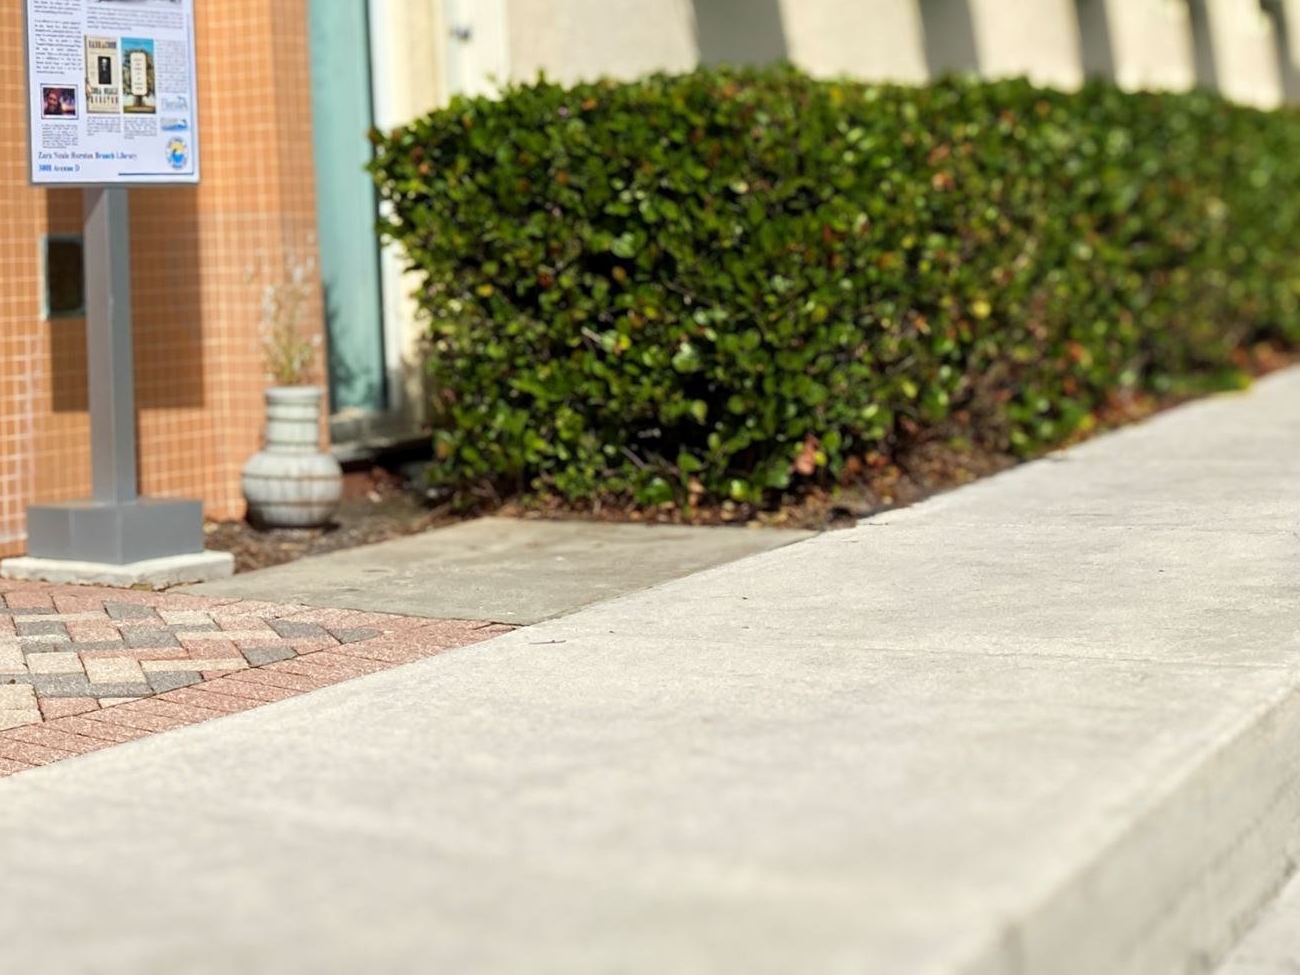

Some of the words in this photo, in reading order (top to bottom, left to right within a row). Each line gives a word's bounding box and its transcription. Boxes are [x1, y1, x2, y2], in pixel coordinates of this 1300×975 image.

[38, 151, 52, 160] Zora
[53, 151, 69, 160] Neale
[71, 151, 93, 160] Hurston
[95, 152, 115, 160] Branch
[116, 152, 138, 161] Library
